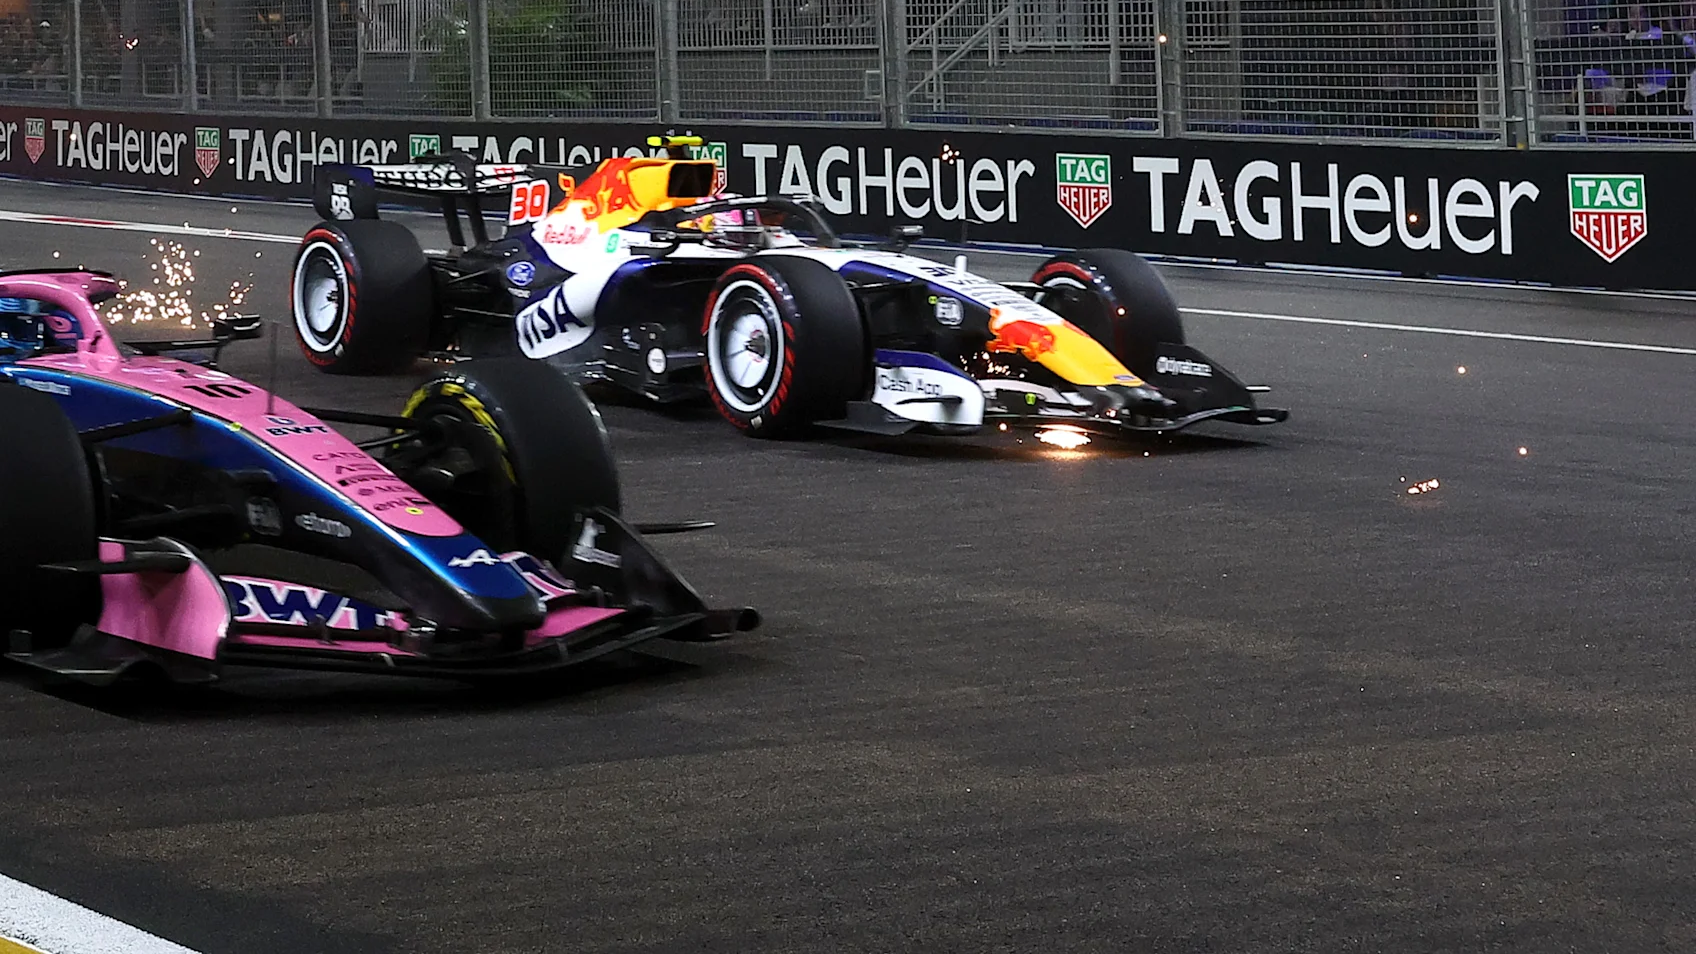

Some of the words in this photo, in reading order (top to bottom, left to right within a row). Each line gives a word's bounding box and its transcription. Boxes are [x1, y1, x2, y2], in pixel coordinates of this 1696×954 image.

[26, 120, 44, 137] TAG
[196, 130, 219, 148] TAG
[52, 119, 188, 177] TAGHeuer
[452, 135, 669, 167] TAGH
[689, 144, 725, 163] TAG
[742, 143, 1036, 223] TAGHeuer
[1060, 158, 1106, 183] TAG
[512, 183, 548, 221] 30
[1059, 184, 1109, 224] HEUER
[1133, 156, 1540, 256] TAGHeuer
[1574, 179, 1640, 207] TAG
[1573, 212, 1645, 258] HEUER
[183, 384, 252, 399] 10
[265, 425, 328, 436] BWT
